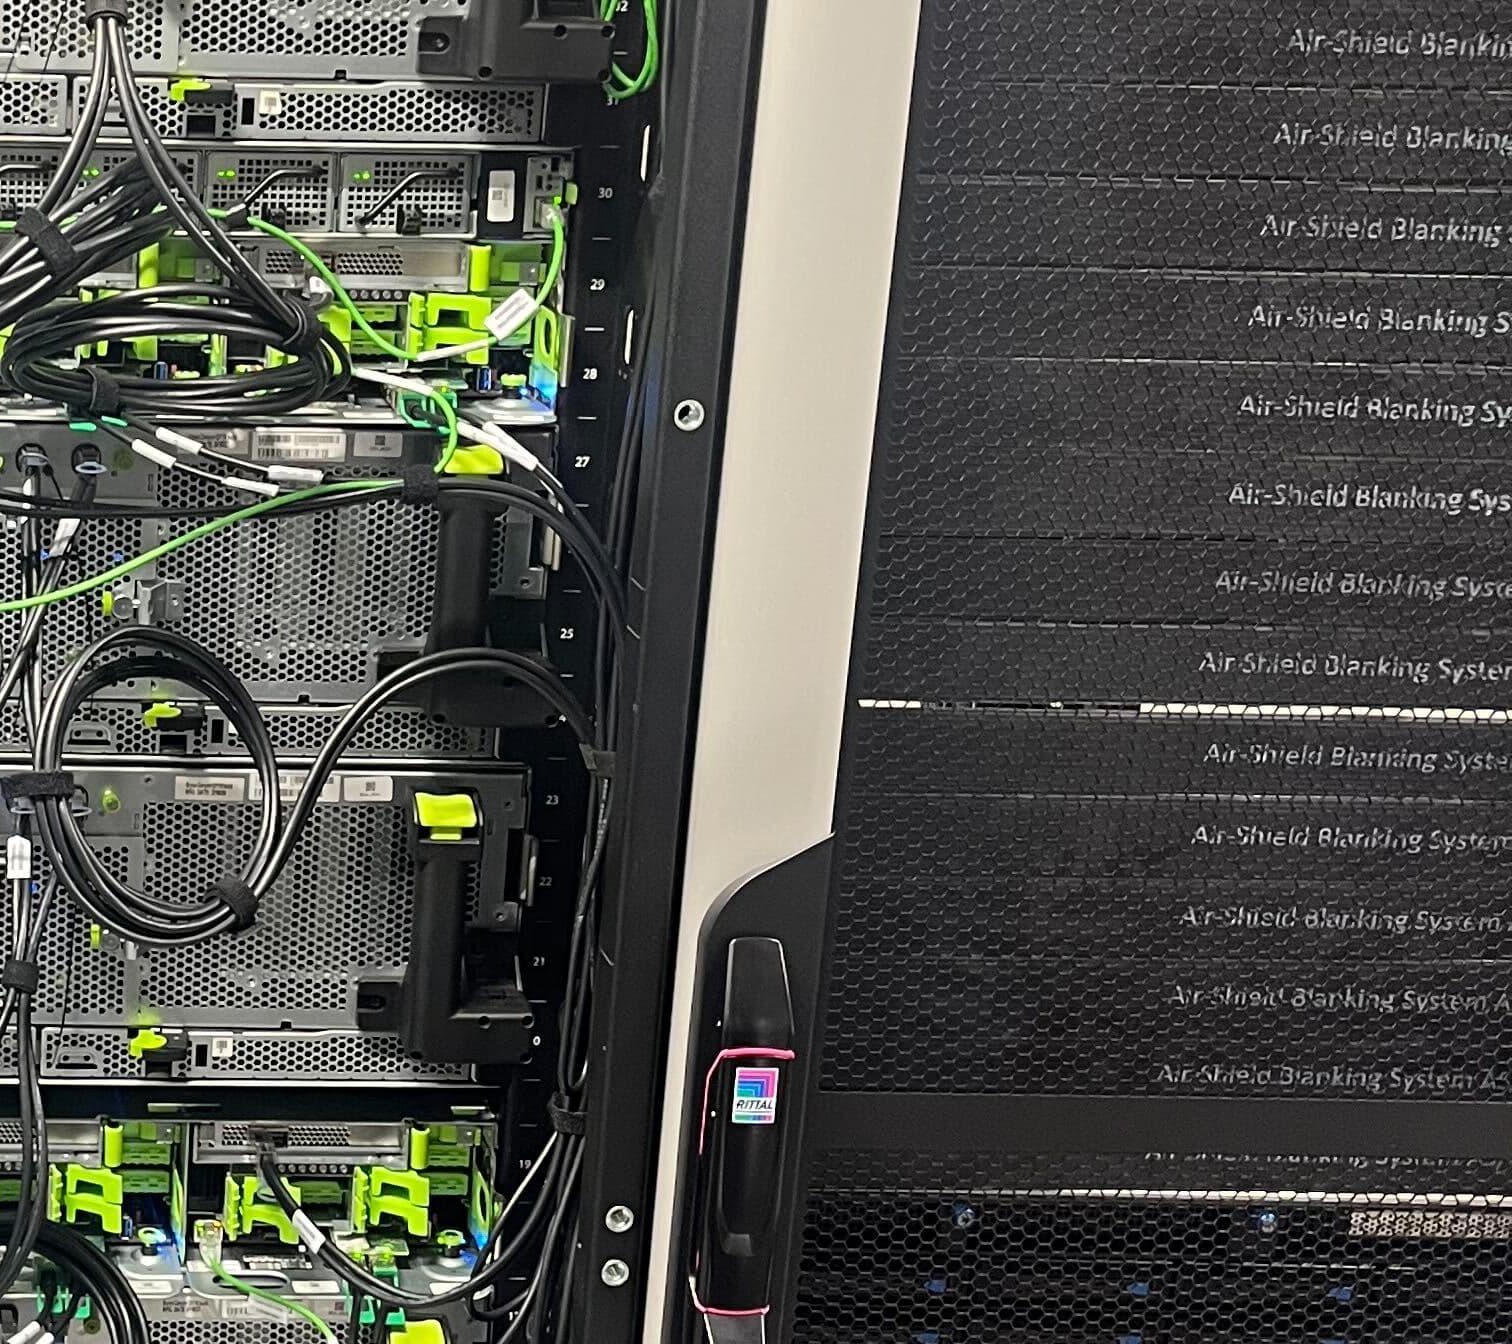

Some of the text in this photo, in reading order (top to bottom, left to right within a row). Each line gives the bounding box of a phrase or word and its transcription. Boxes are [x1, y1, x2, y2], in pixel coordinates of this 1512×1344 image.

[598, 187, 613, 199] 30
[1390, 216, 1502, 248] Blanking
[590, 278, 605, 291] 29
[1378, 308, 1489, 338] Blanking
[583, 367, 598, 380] 28
[1238, 394, 1360, 419] Air-Shield
[1367, 397, 1476, 427] Blanking
[575, 456, 590, 468] 27
[1228, 483, 1349, 507] Air-Shield
[1354, 485, 1463, 516] Blanking
[1215, 570, 1335, 595] Air-Shield
[1340, 573, 1448, 601] Blanking
[560, 628, 574, 639] 25
[1198, 652, 1317, 676] AirShield
[1324, 655, 1431, 683] Blanking
[1203, 744, 1323, 767] Air-Shield
[546, 794, 559, 806] 23
[1190, 825, 1310, 849] Air-Shield
[1317, 828, 1423, 854] Blanking
[539, 876, 553, 887] 22
[1304, 908, 1410, 935] Blanking
[1414, 911, 1501, 935] System
[533, 956, 545, 967] 21
[1291, 987, 1395, 1013] Blanking
[1279, 1066, 1382, 1093] Blanking
[735, 1099, 774, 1110] RITTAL
[519, 1159, 532, 1169] 19
